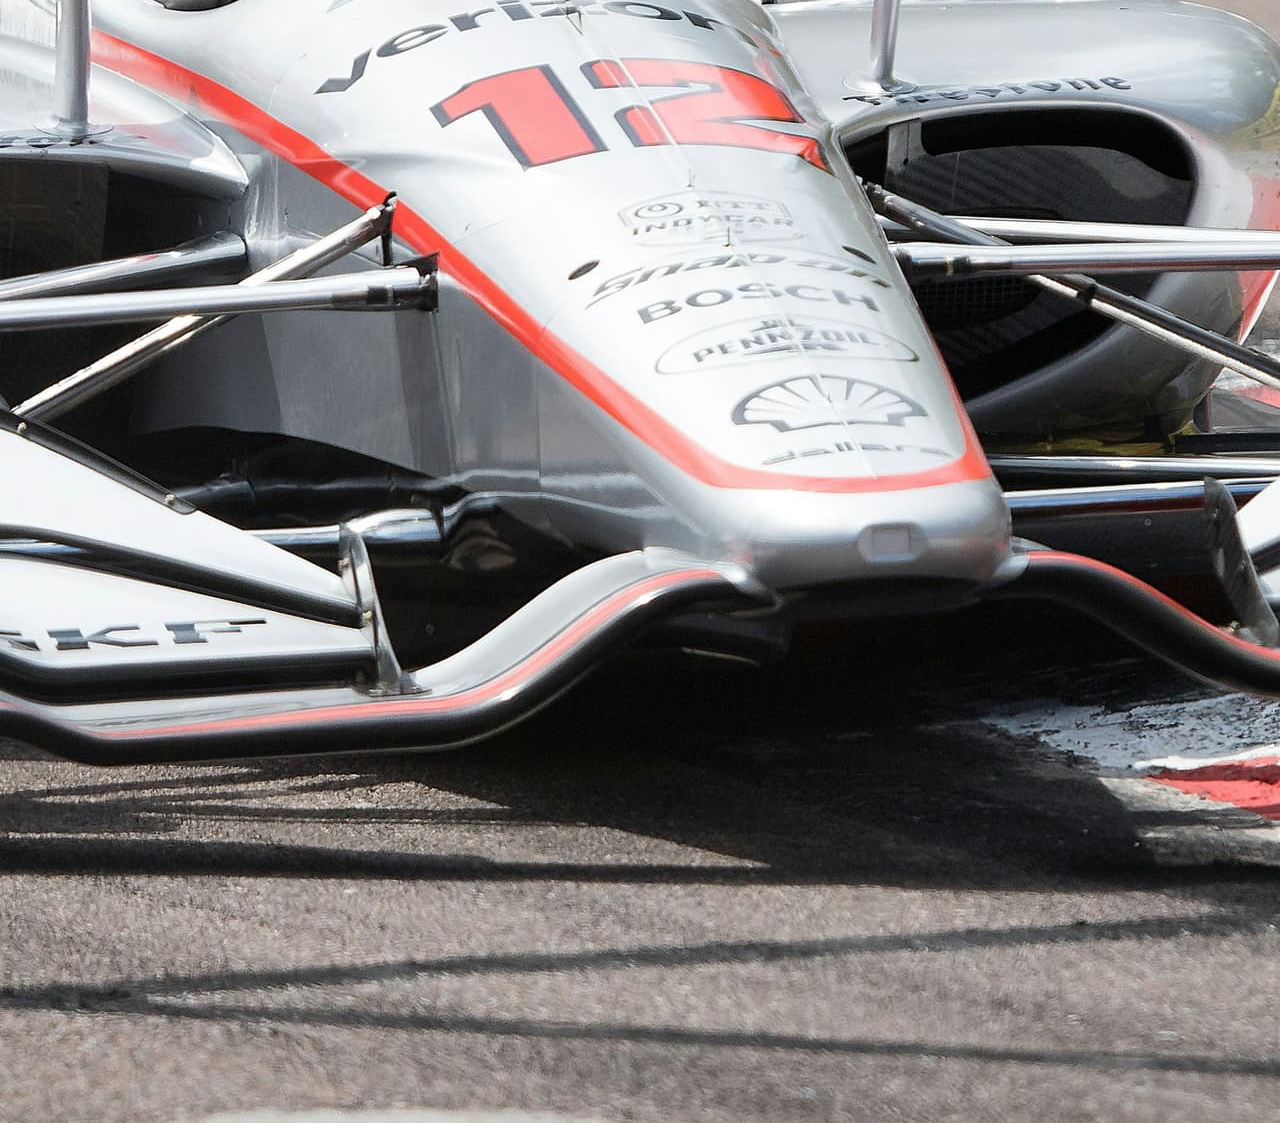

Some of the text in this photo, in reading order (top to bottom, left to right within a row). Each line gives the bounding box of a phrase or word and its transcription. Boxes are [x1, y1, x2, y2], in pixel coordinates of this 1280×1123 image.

[429, 57, 830, 174] 12
[636, 281, 881, 325] BOSCH
[692, 329, 880, 364] PENNZOIL
